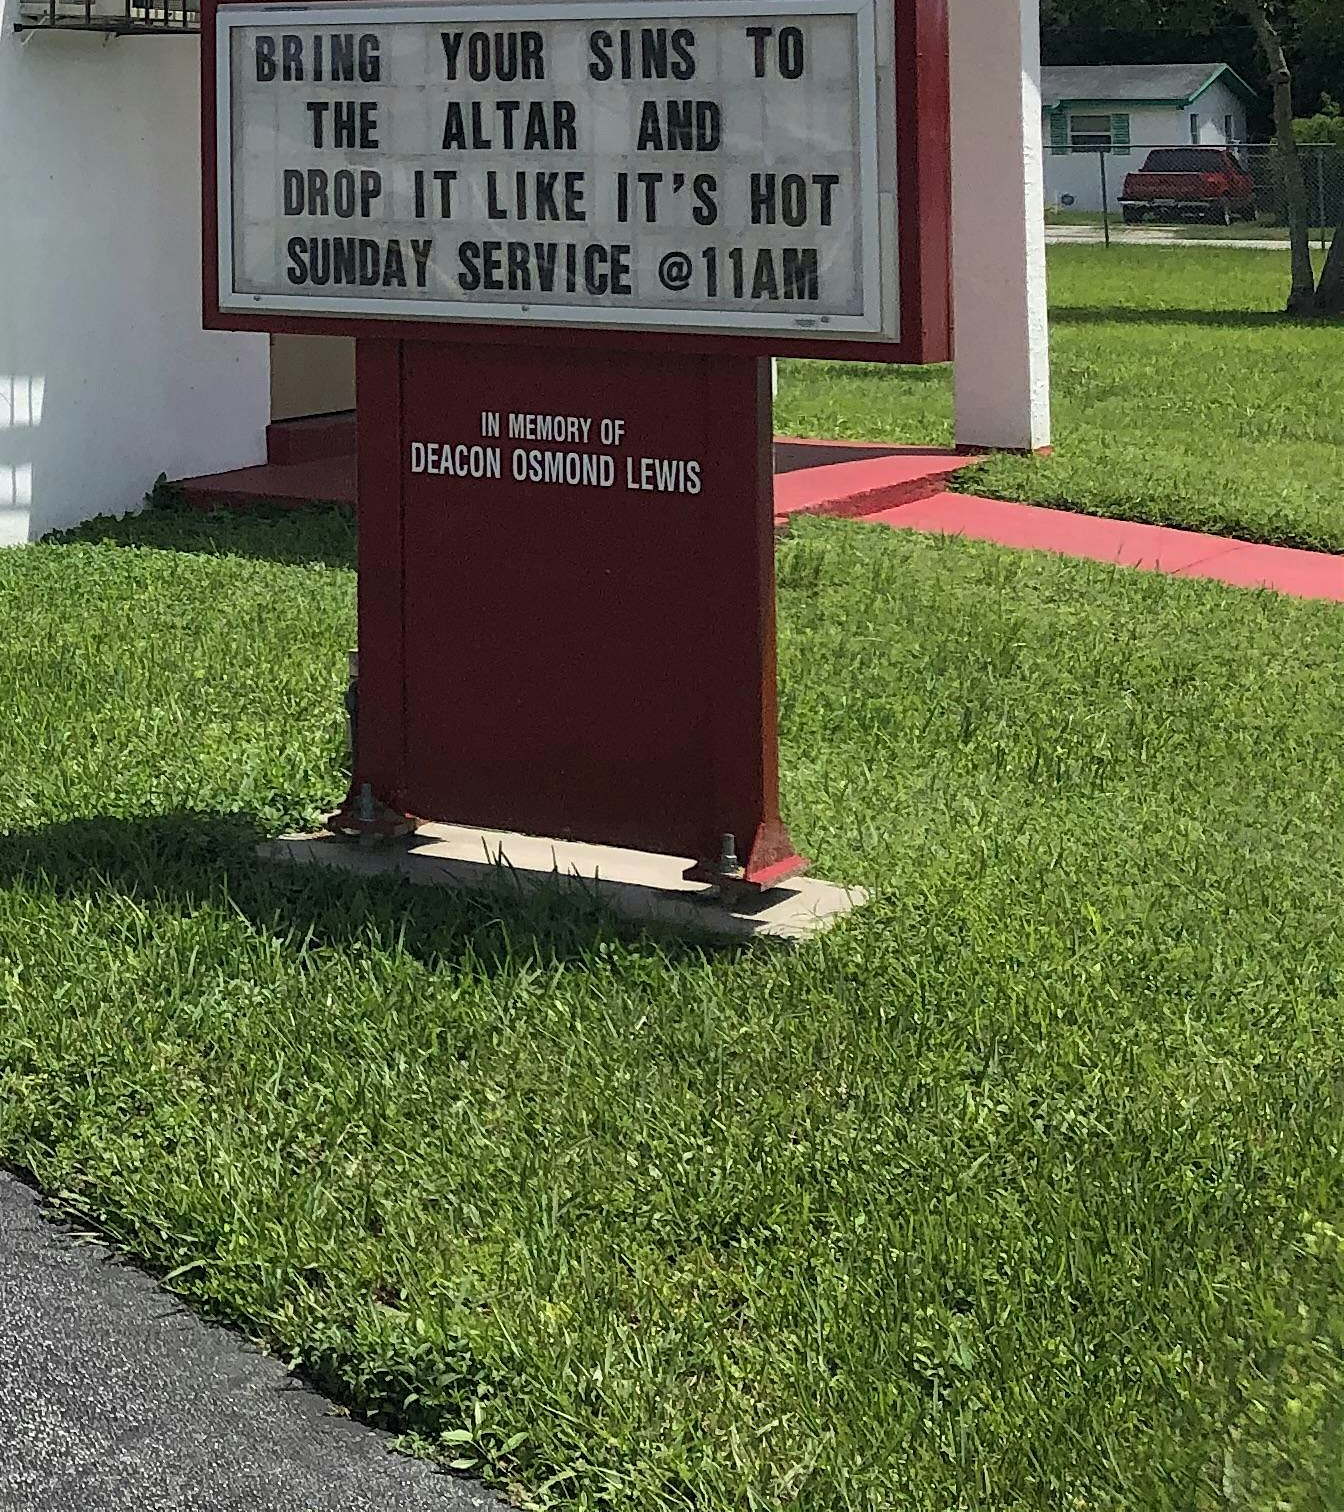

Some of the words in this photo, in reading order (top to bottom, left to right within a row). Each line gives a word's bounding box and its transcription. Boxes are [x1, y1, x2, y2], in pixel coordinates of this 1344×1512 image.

[254, 33, 380, 83] BRING
[441, 30, 545, 82] YOUR
[589, 27, 696, 81] SINS
[746, 26, 804, 79] TO
[306, 101, 379, 150] THE
[442, 100, 576, 150] ALTAR
[636, 99, 721, 152] AND
[283, 168, 382, 218] DROP
[413, 170, 458, 219] IT
[486, 170, 586, 222] LIKE
[616, 171, 718, 226] IT'S
[750, 174, 840, 227] HOT
[286, 236, 433, 289] SUNDAY
[458, 242, 631, 296] SERVICE
[658, 246, 820, 300] @11AM
[481, 412, 500, 438] IN
[508, 413, 591, 444] MEMORY
[600, 418, 625, 445] OF
[412, 442, 501, 479] DEACON
[512, 449, 615, 487] OSMOND
[626, 456, 701, 494] LEWIS
